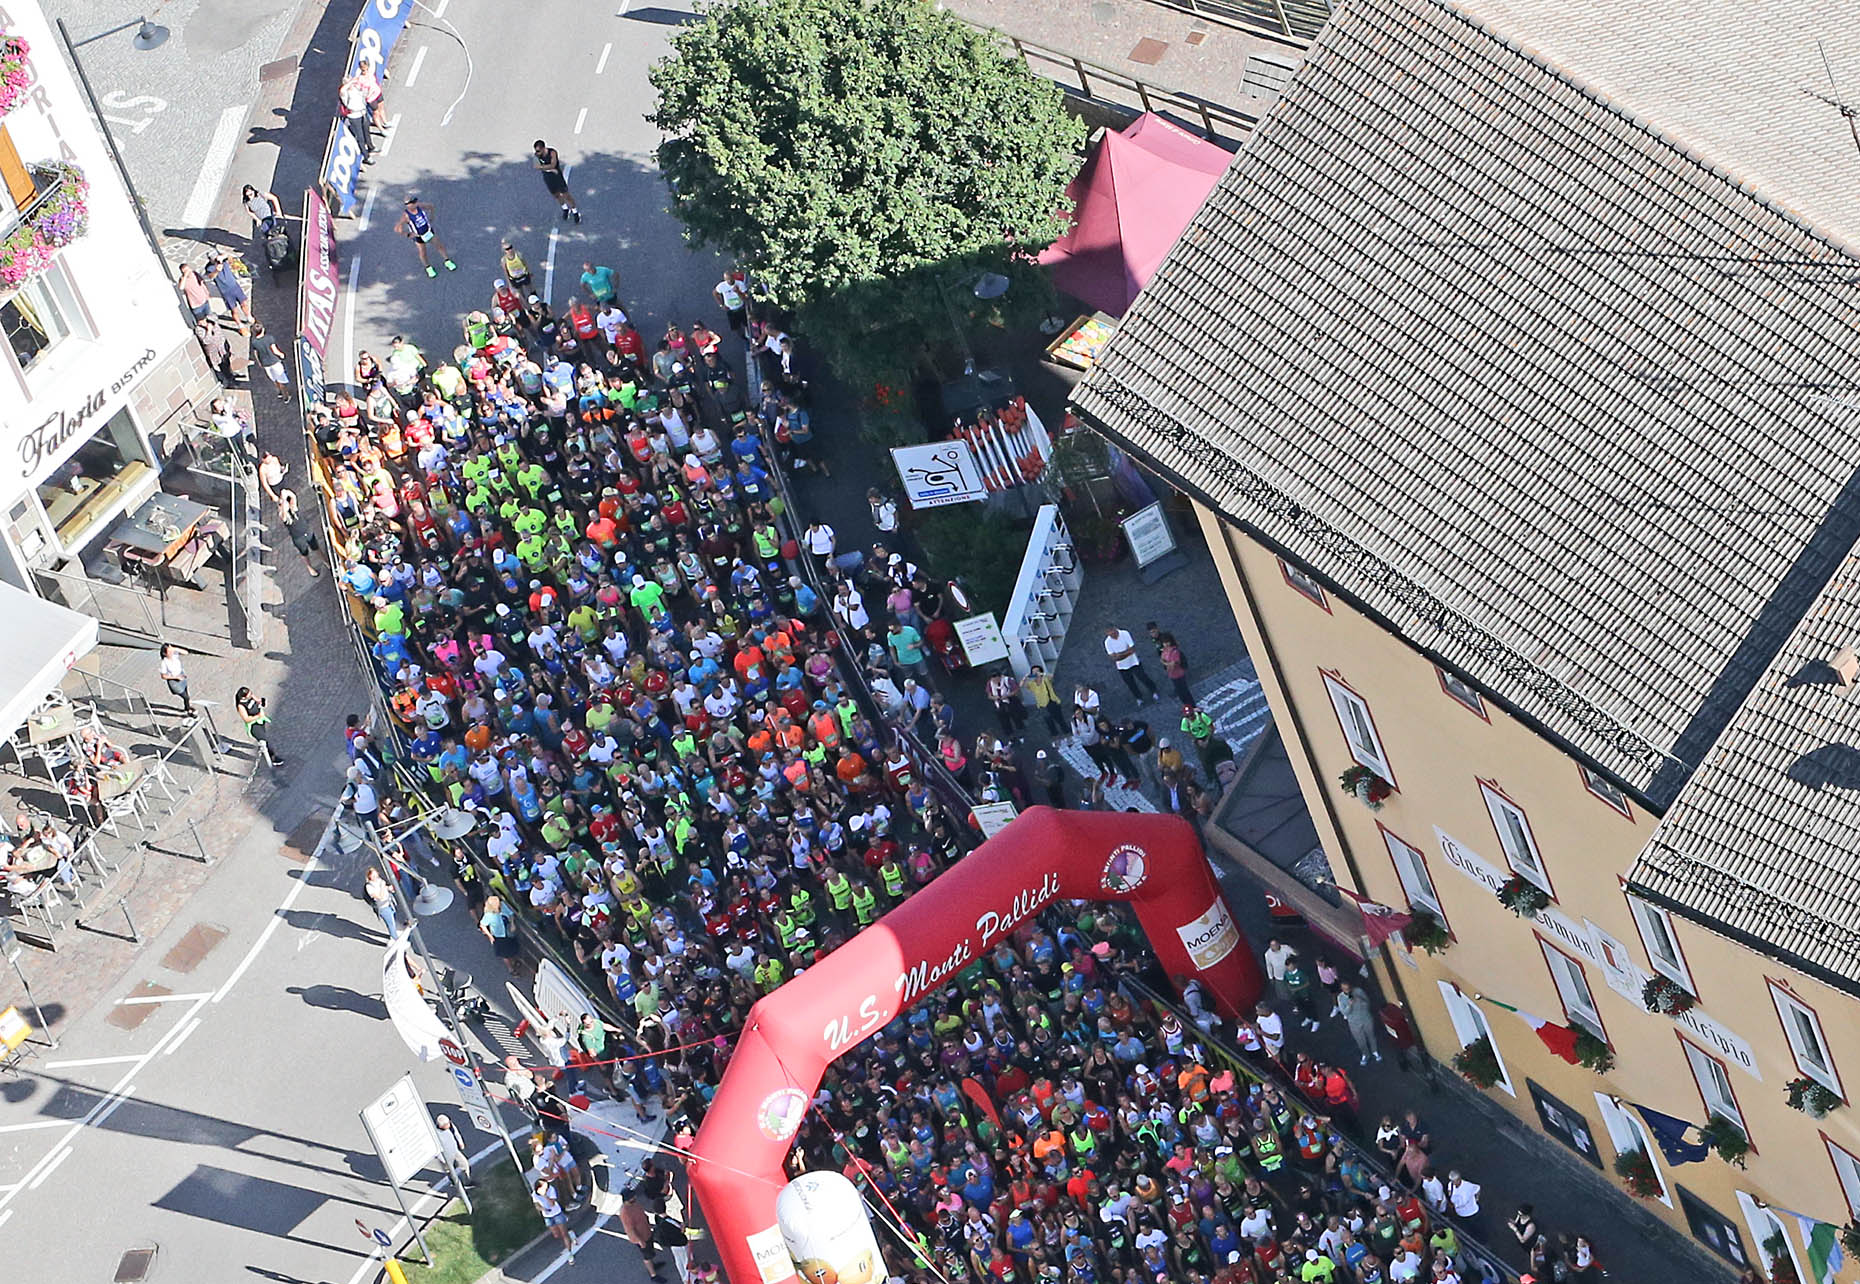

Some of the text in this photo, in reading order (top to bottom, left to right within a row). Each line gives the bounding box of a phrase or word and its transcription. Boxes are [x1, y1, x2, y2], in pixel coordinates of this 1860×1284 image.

[308, 269, 339, 350] ITAS
[17, 389, 107, 478] Faloria
[824, 872, 1061, 1051] U.S. Monti Pallidi
[1186, 913, 1229, 949] MOENA
[440, 1042, 465, 1063] STOP
